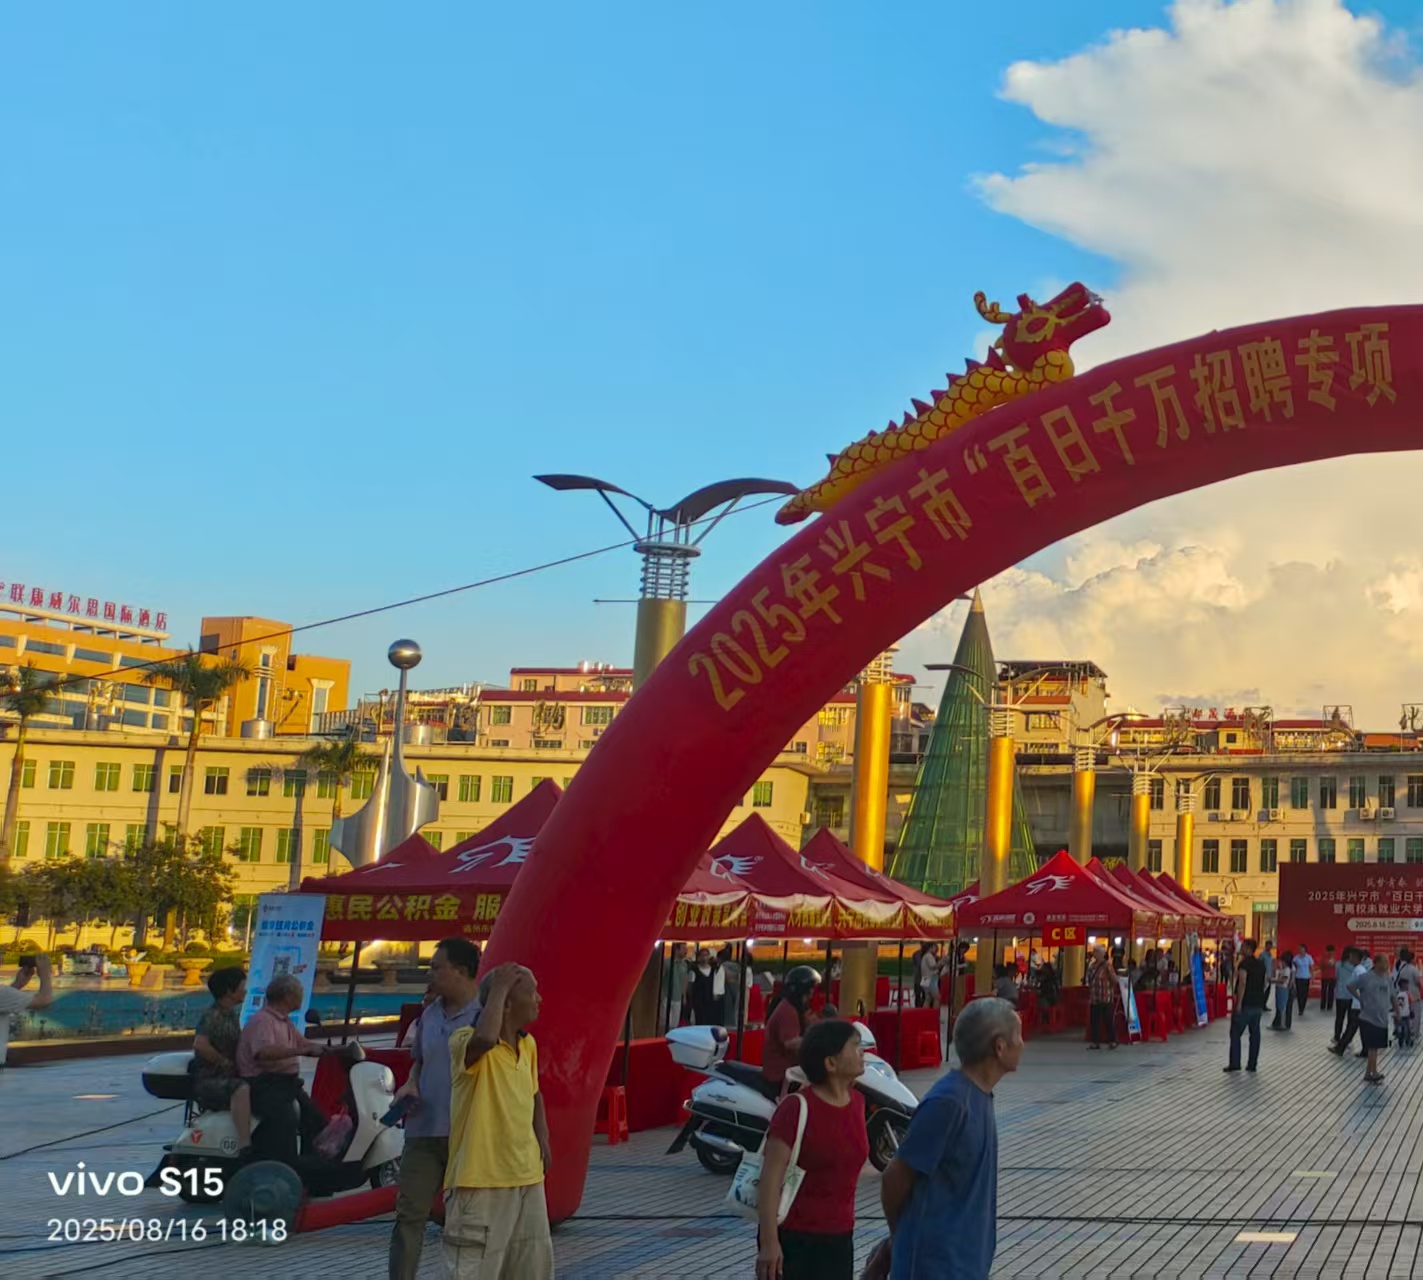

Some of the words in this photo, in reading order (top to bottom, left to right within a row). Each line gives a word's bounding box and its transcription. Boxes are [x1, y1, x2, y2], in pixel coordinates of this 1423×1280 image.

[325, 893, 461, 921] 惠民公积金
